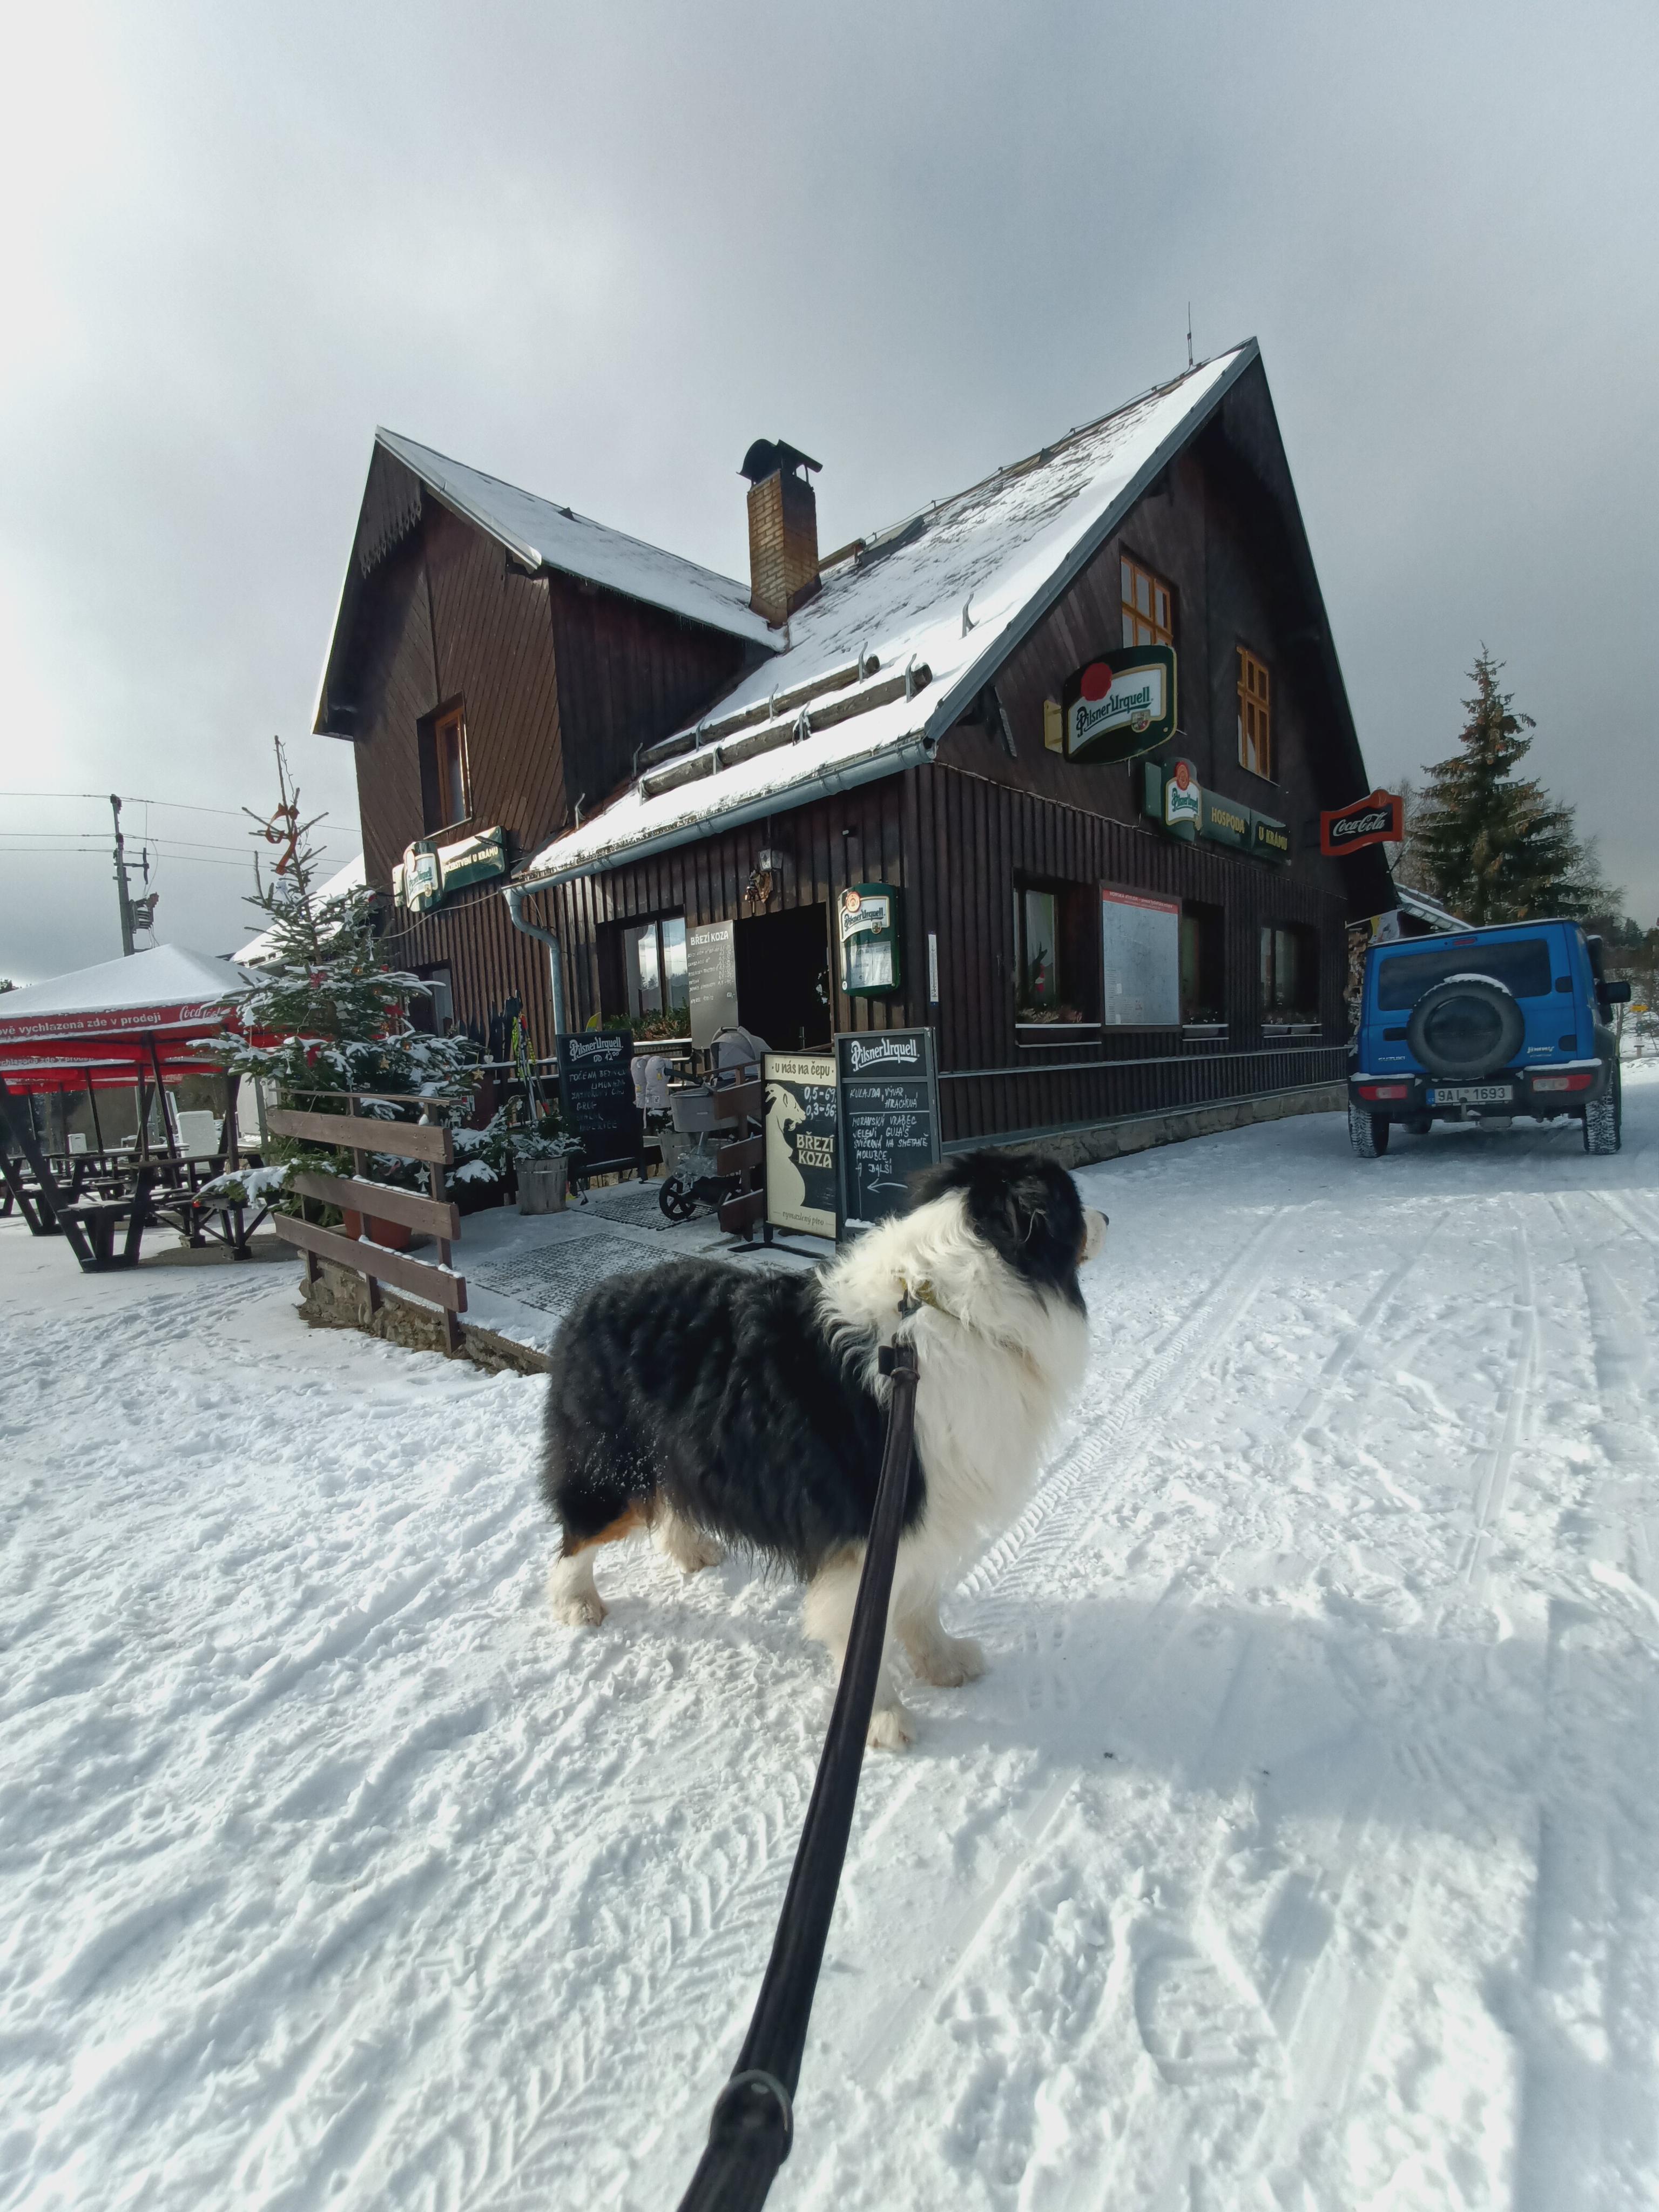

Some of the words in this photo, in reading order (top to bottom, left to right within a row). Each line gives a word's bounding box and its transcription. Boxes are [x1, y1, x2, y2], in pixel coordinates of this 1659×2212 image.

[1076, 706, 1111, 738] Pilsner
[1211, 807, 1245, 834] HOSPODA
[1258, 826, 1264, 841] U
[473, 854, 477, 862] U
[690, 932, 710, 946] BŘEZÍ
[711, 930, 729, 942] KOZA
[0, 1026, 16, 1035] vě
[19, 1019, 84, 1035] vychlazená
[87, 1018, 107, 1027] zde
[120, 1012, 161, 1026] prodeji
[851, 1040, 884, 1072] Pilsner
[881, 1037, 916, 1064] Urquell
[781, 1060, 797, 1074] nás
[798, 1063, 809, 1074] na
[811, 1060, 830, 1077] čepu
[1473, 1087, 1505, 1100] 1693
[797, 1132, 834, 1153] BŘEZÍ
[886, 1139, 894, 1148] NA
[799, 1150, 832, 1169] KOZA
